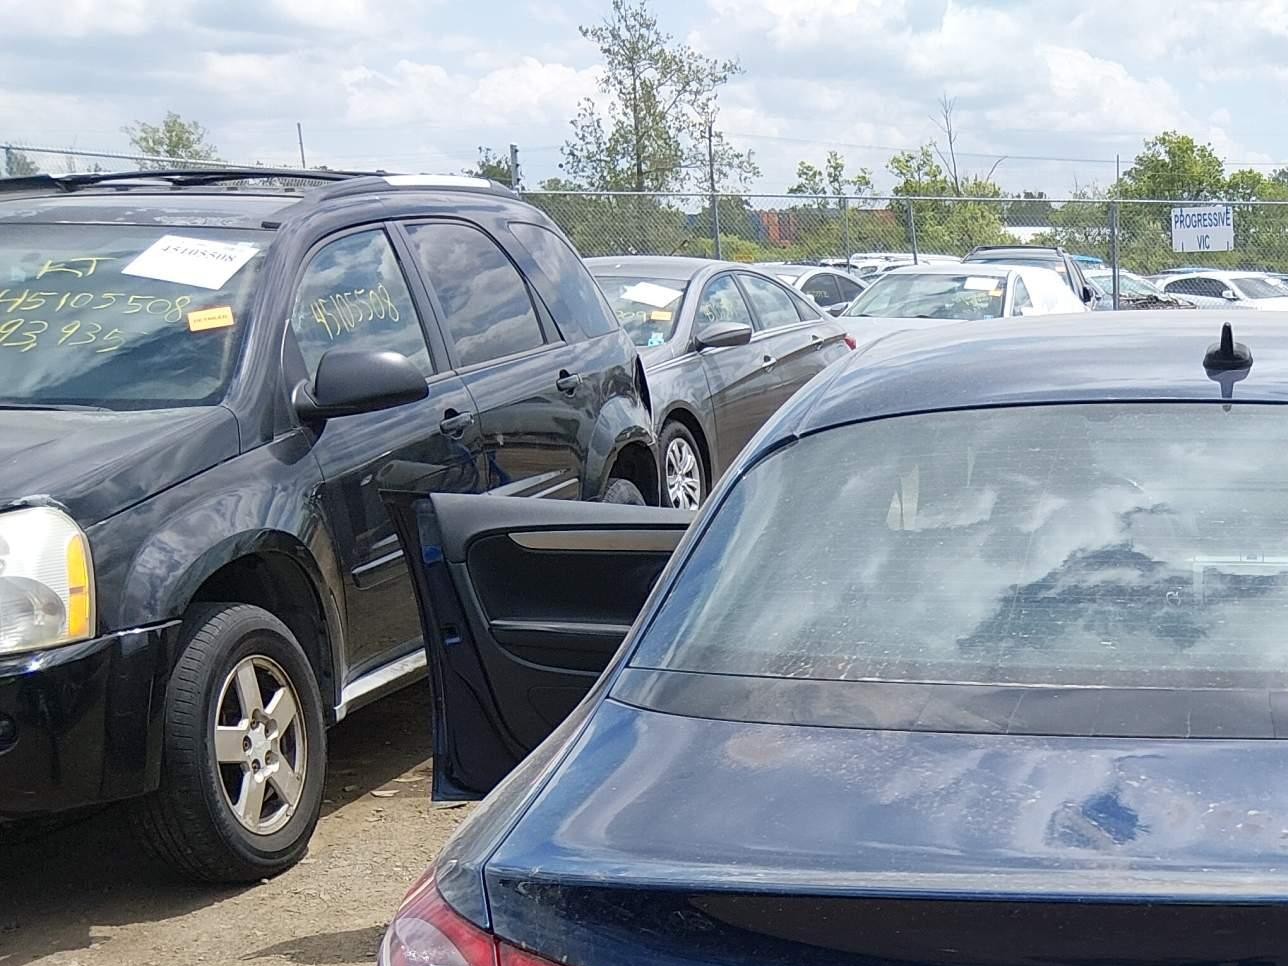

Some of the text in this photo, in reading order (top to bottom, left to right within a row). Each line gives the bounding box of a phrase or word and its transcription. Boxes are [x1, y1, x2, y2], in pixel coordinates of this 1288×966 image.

[1174, 211, 1231, 229] PROGRESSIVE
[1196, 234, 1210, 250] VIC
[36, 257, 119, 280] KT
[310, 282, 400, 341] 45105508
